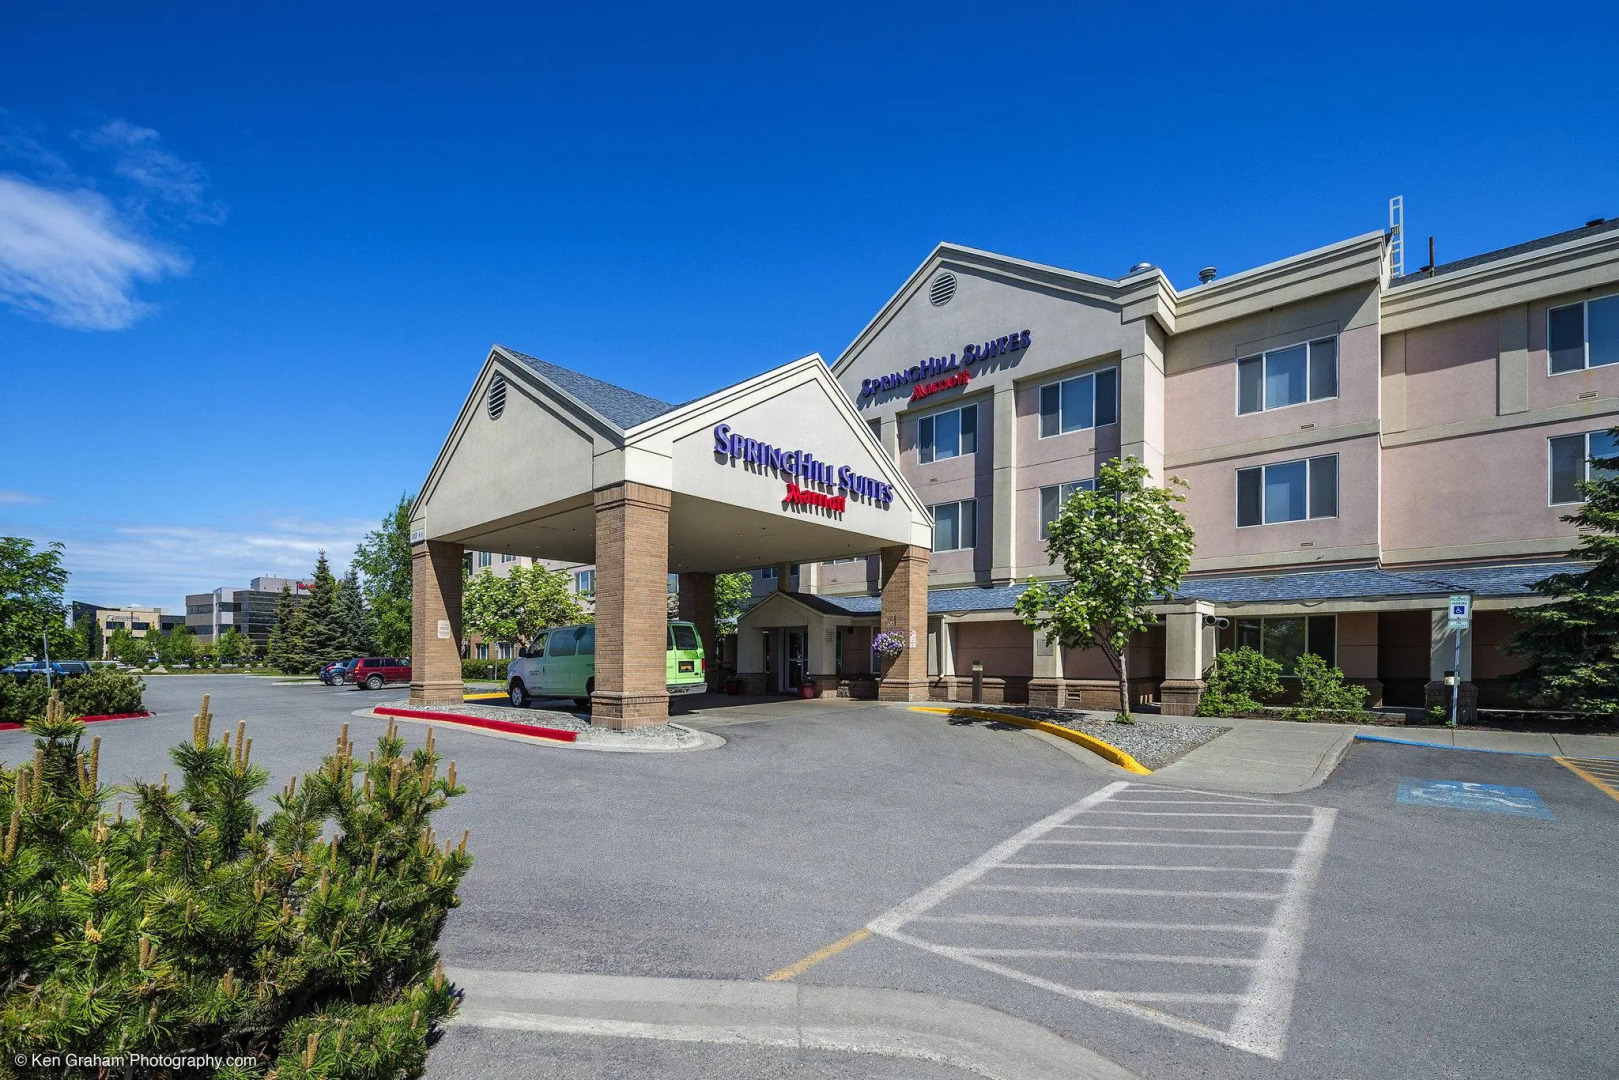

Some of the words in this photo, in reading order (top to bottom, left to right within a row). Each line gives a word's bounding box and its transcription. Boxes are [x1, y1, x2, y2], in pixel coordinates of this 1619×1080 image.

[962, 329, 1032, 366] SUITES
[910, 369, 970, 402] Marriott
[783, 482, 846, 513] Marriott
[838, 465, 894, 504] SUITES
